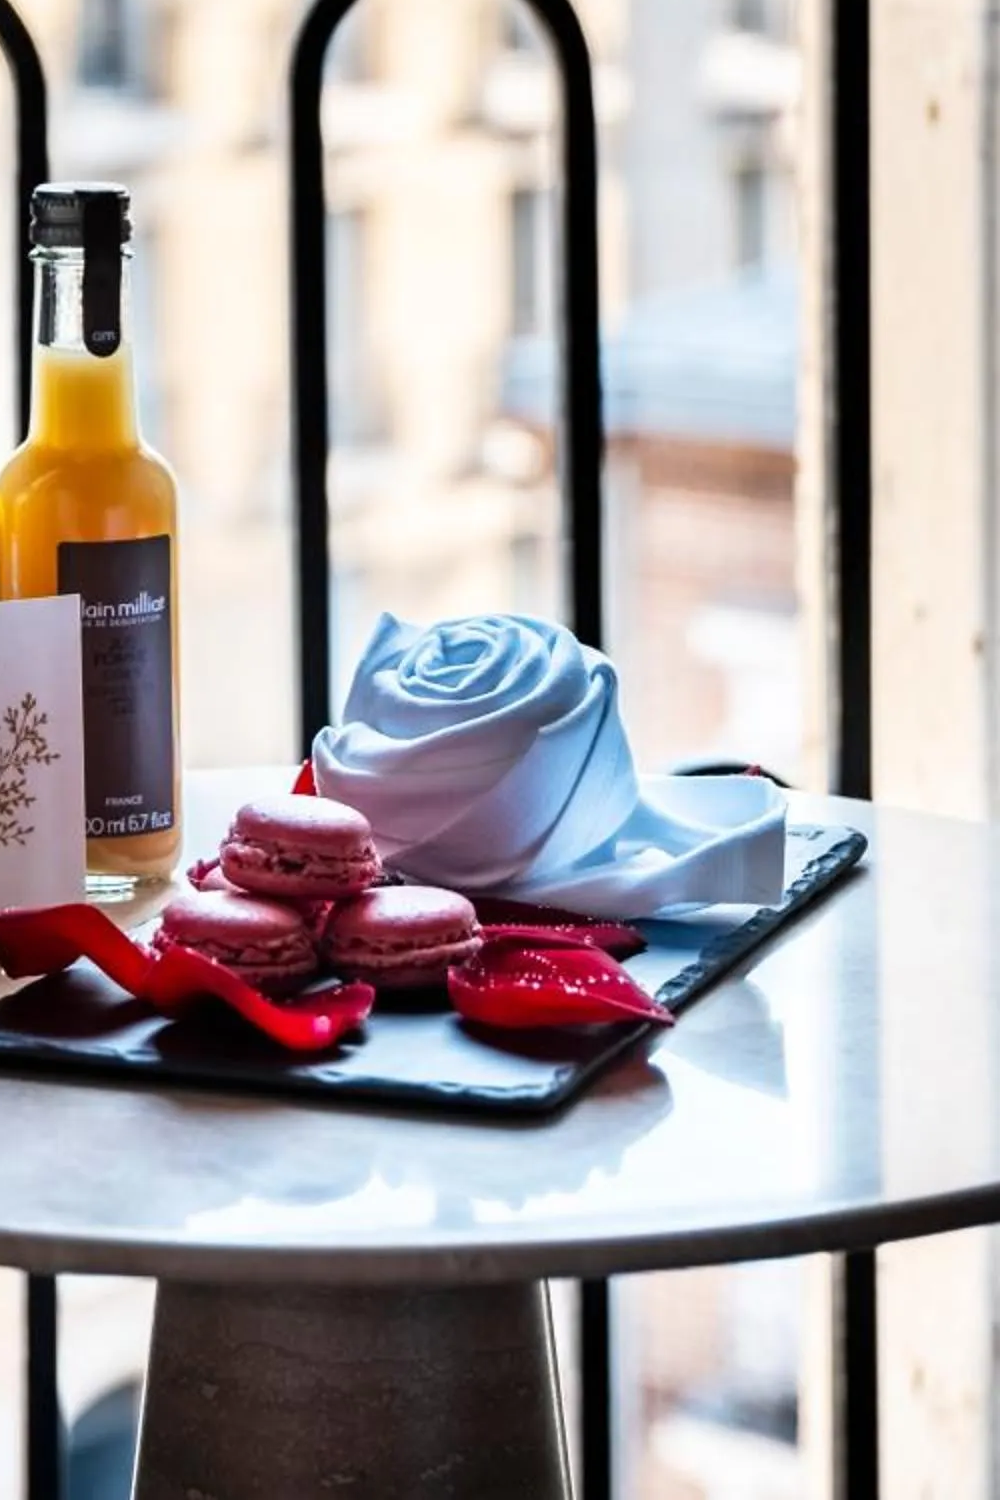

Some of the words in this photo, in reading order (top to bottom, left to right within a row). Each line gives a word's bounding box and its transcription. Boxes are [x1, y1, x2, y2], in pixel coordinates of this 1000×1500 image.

[92, 330, 116, 342] am
[81, 598, 115, 619] lain
[117, 591, 166, 617] milliat
[105, 794, 144, 806] FRANCE
[107, 816, 126, 835] ml
